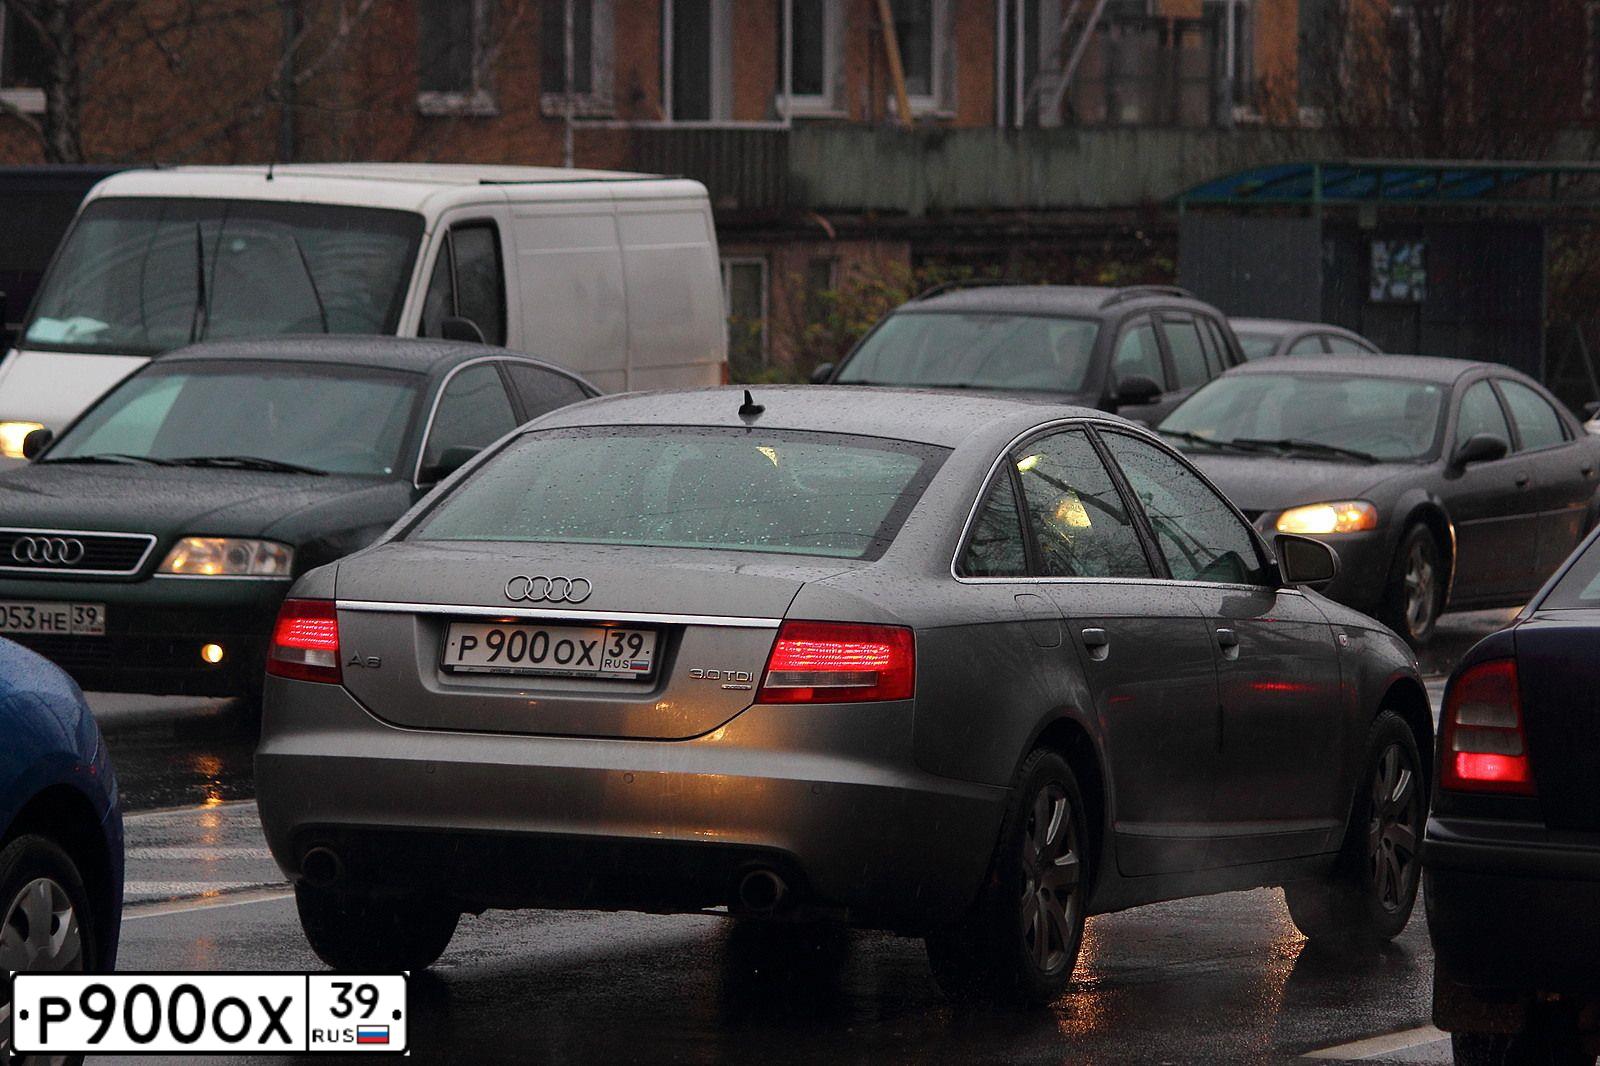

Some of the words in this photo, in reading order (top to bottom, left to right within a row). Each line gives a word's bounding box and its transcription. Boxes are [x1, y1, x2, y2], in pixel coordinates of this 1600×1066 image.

[75, 606, 97, 625] 39
[608, 632, 643, 658] 39
[604, 659, 629, 669] RUS
[688, 668, 720, 680] 3.0
[722, 670, 753, 682] TDI
